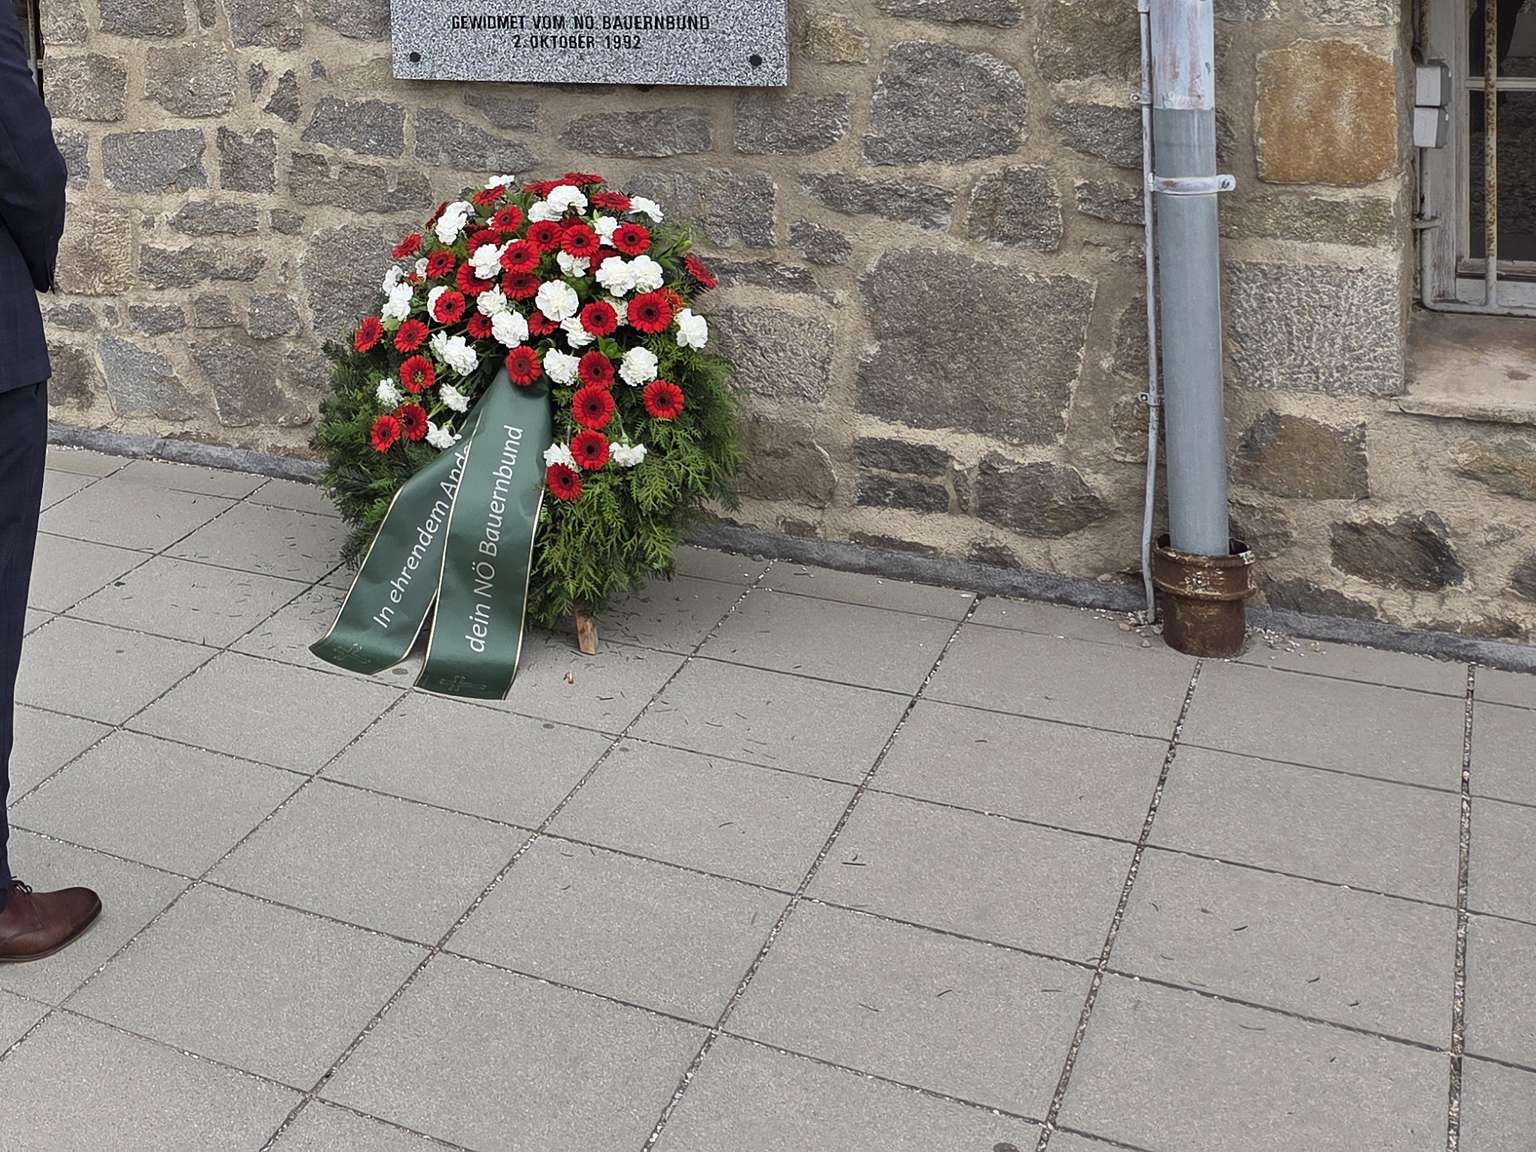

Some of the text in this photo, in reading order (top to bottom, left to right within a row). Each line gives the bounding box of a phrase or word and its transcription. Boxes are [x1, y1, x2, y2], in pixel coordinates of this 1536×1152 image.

[451, 15, 526, 30] GEWIDMET
[532, 15, 565, 30] VOM
[602, 15, 710, 30] BAUERNBUND
[530, 34, 595, 49] OKTOBER
[605, 34, 642, 49] 1992
[372, 605, 396, 629] In
[389, 499, 450, 604] ehrendem
[465, 424, 524, 654] dein NÖ Bauernbund
